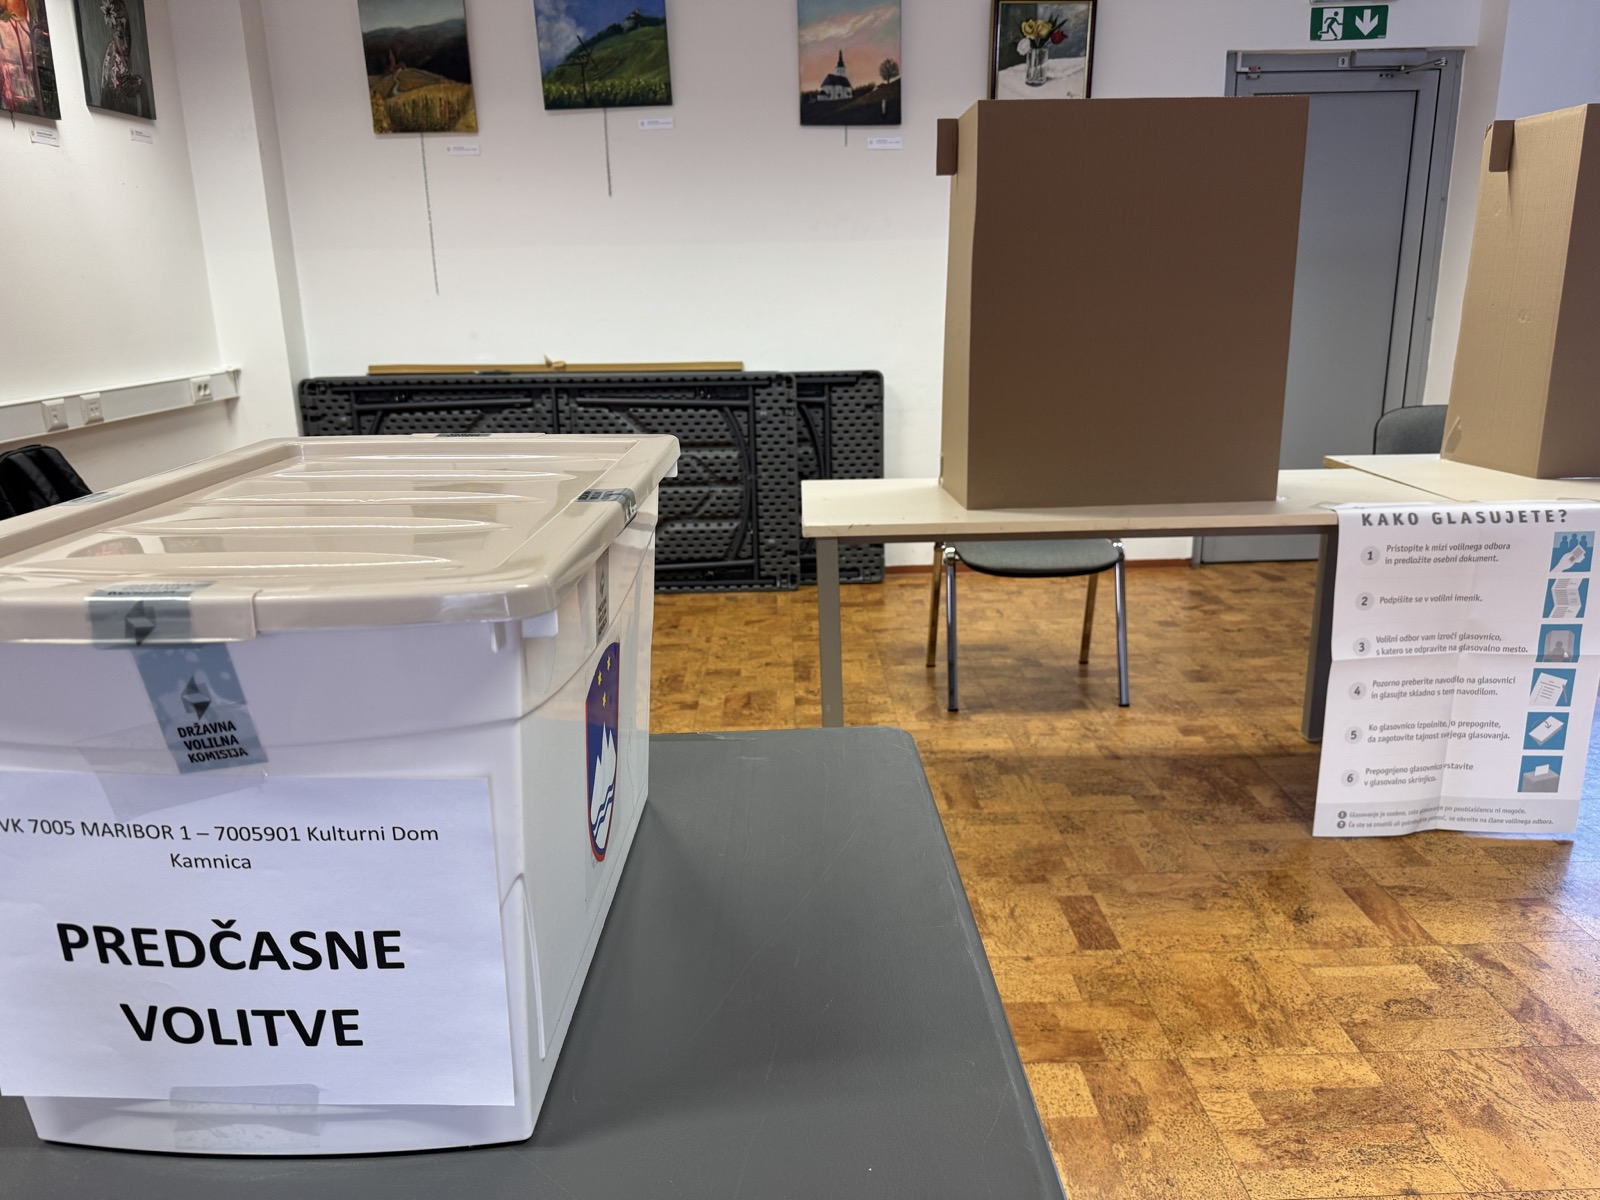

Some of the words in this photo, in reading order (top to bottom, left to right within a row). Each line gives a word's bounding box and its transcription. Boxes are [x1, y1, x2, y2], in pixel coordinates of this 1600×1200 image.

[1361, 512, 1419, 526] KAKO
[1431, 509, 1568, 525] GLASUJETE?
[1386, 544, 1424, 554] Pristopite
[1432, 543, 1448, 551] mizi
[1449, 542, 1482, 552] volilnega
[1484, 542, 1511, 550] odbora
[1366, 551, 1373, 560] 1
[1385, 556, 1392, 564] in
[1394, 556, 1431, 566] predložite
[1433, 555, 1458, 563] osebni
[1459, 554, 1498, 562] dokument.
[1361, 597, 1368, 606] 2
[1380, 596, 1414, 605] Podpišite
[1430, 594, 1453, 602] volilni
[1454, 594, 1483, 602] imenik.
[1376, 635, 1398, 644] Volilni
[1400, 634, 1419, 642] odbor
[1437, 632, 1457, 640] izroči
[1458, 632, 1502, 642] glasovnico,
[1358, 642, 1365, 652] 3
[1382, 648, 1403, 656] katero
[1414, 645, 1447, 655] odpravite
[1458, 644, 1500, 654] glasovalno
[1502, 645, 1528, 653] mesto.
[1372, 680, 1400, 688] Pozorno
[1402, 678, 1434, 688] preberite
[1478, 676, 1516, 686] glasovnici
[1354, 686, 1360, 696] 4
[1380, 690, 1407, 700] glasujte
[1409, 688, 1436, 697] skladno
[1442, 688, 1454, 696] tem
[1456, 687, 1498, 696] navodilom.
[177, 720, 237, 738] DRŽAVNA
[1379, 722, 1416, 732] glasovnico
[1458, 720, 1500, 729] prepognite,
[1350, 730, 1357, 740] 5
[1368, 735, 1376, 743] da
[1378, 734, 1414, 744] zagotovite
[1416, 732, 1440, 742] tajnost
[1468, 731, 1510, 740] glasovanja.
[184, 734, 240, 751] VOLILNA
[188, 748, 248, 763] KOMISIJA
[1346, 773, 1354, 782] 6
[1370, 776, 1406, 787] glasovalno
[28, 819, 76, 836] 7005
[80, 821, 174, 841] MARIBOR
[180, 825, 192, 841] 1
[214, 825, 301, 842] 7005901
[307, 825, 386, 842] Kulturni
[393, 825, 440, 842] Dom
[170, 852, 252, 870] Kamnica
[56, 918, 406, 971] PREDČASNE
[119, 1003, 364, 1048] VOLITVE
